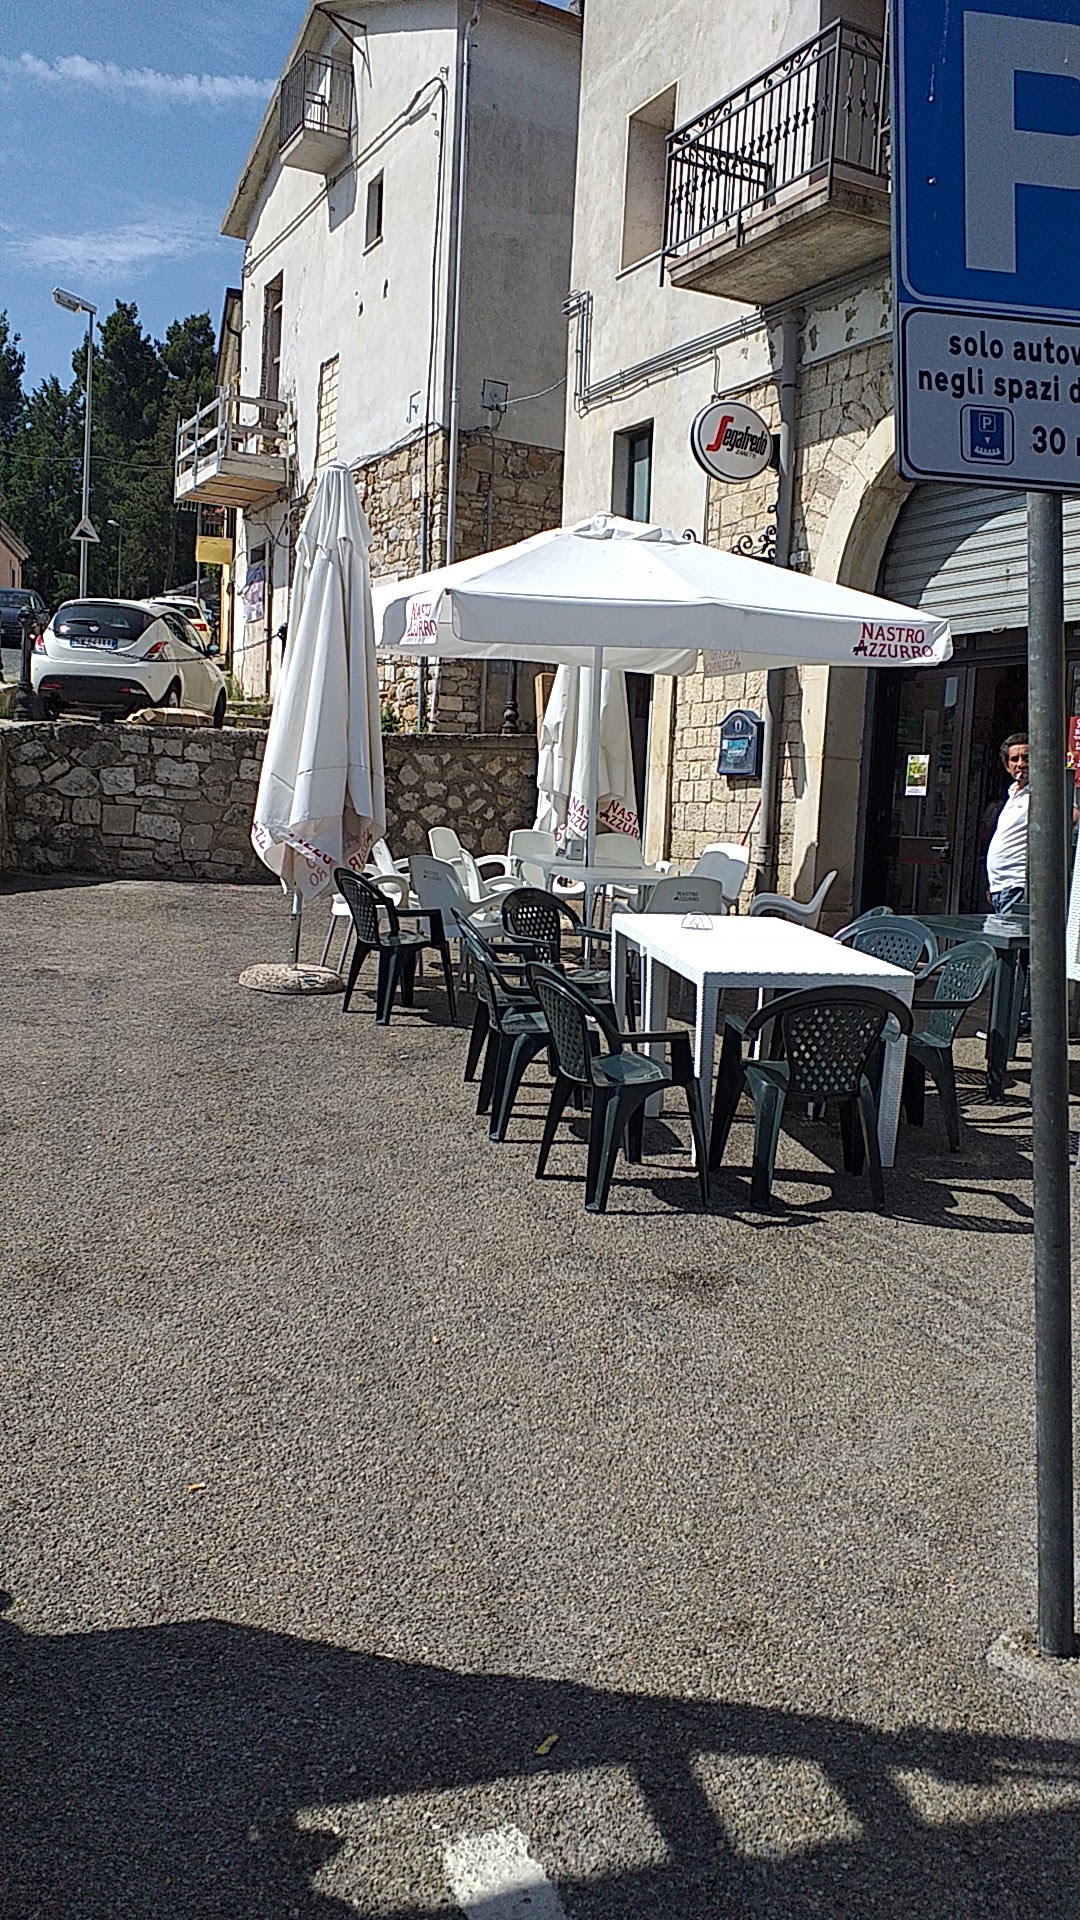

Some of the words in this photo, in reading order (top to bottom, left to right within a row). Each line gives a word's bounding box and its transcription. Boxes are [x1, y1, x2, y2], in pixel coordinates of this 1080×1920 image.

[963, 10, 1080, 273] P
[949, 330, 1004, 359] solo
[918, 366, 984, 399] negli
[993, 374, 1060, 403] spazi
[706, 415, 768, 456] Segafredo
[982, 416, 993, 430] P
[1032, 425, 1066, 455] 30
[861, 621, 925, 643] NASTRO
[853, 639, 934, 658] AZZURRO
